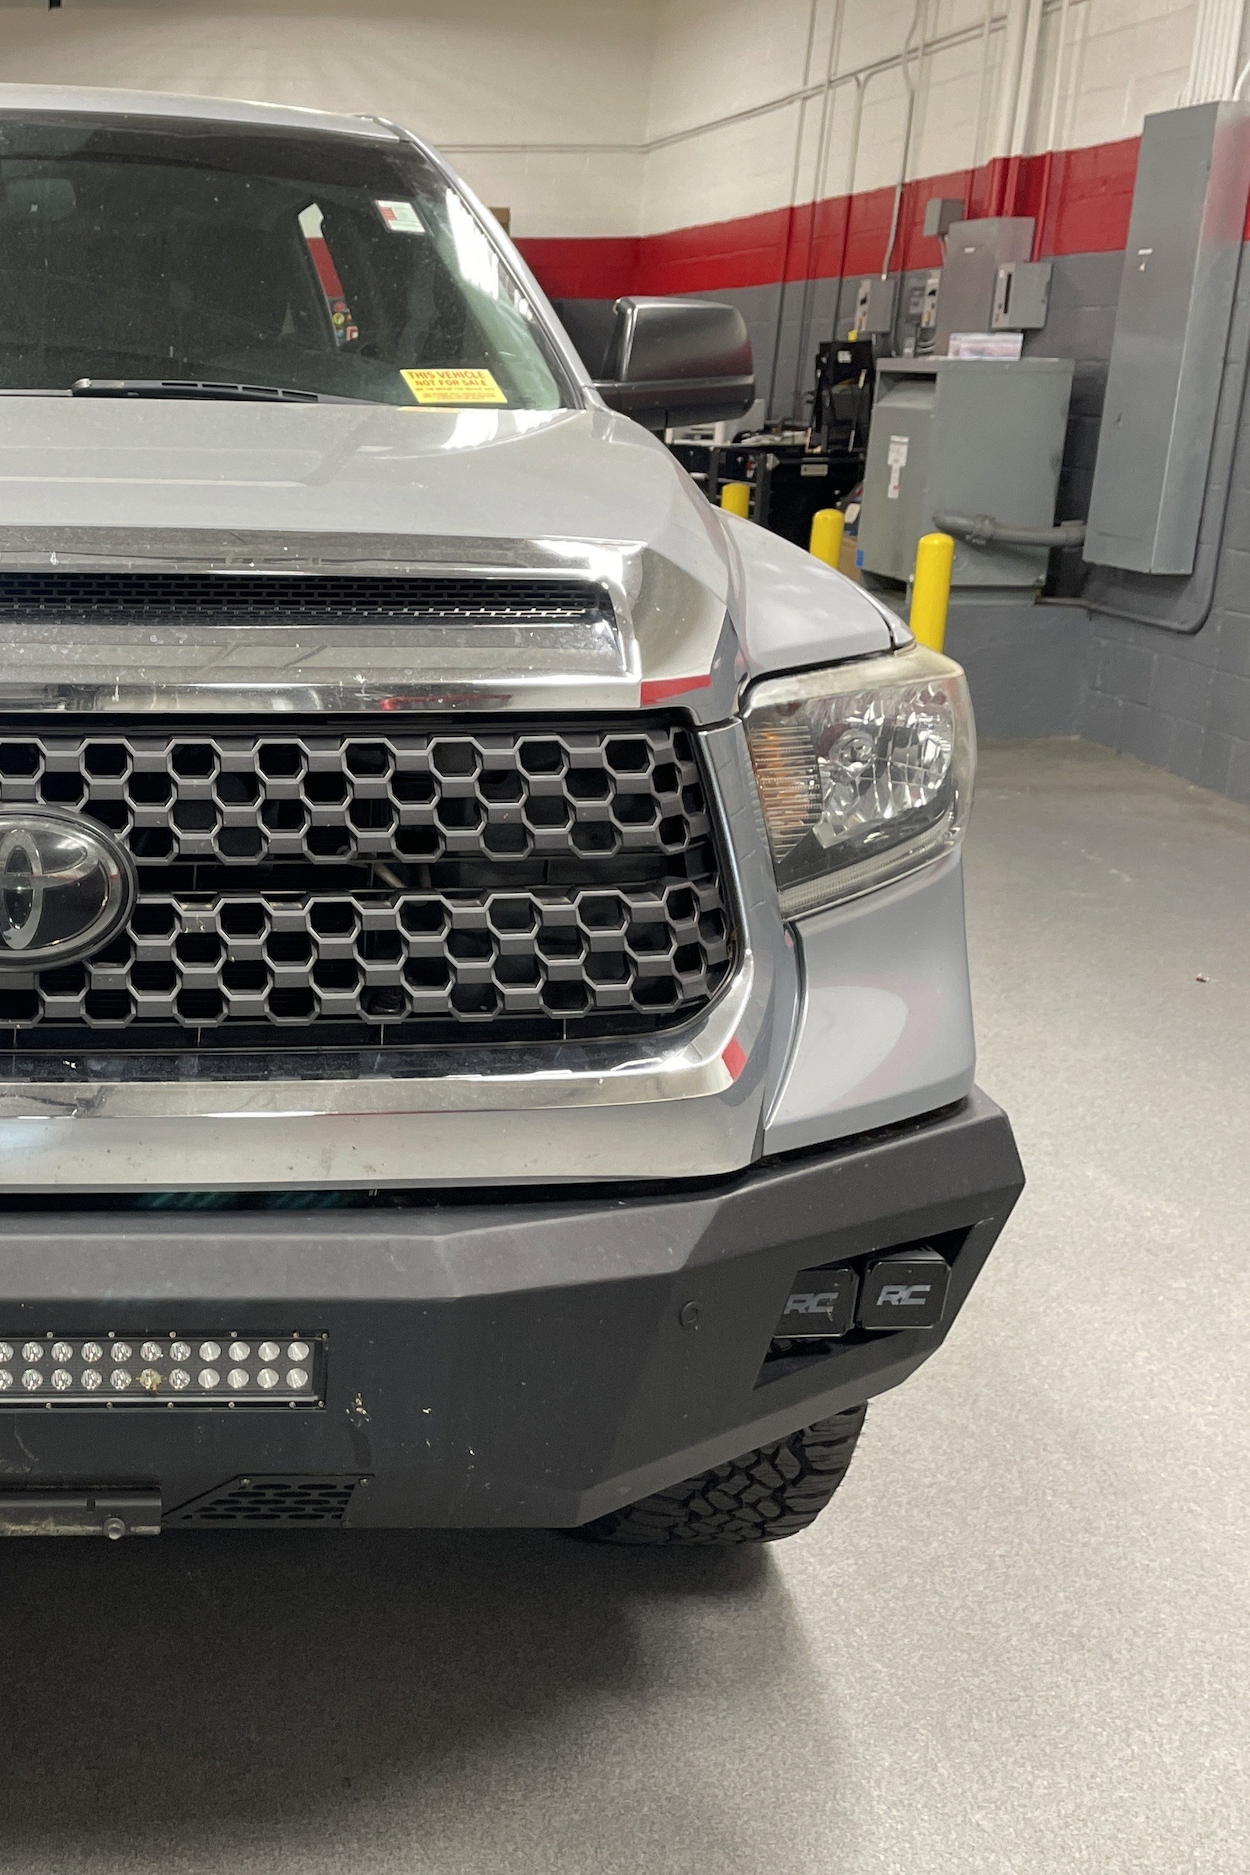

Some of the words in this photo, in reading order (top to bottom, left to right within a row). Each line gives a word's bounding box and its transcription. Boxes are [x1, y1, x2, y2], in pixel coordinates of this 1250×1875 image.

[407, 371, 435, 379] THIS
[436, 371, 485, 379] VEHICLE
[783, 1292, 839, 1315] RC
[876, 1284, 932, 1306] RC
